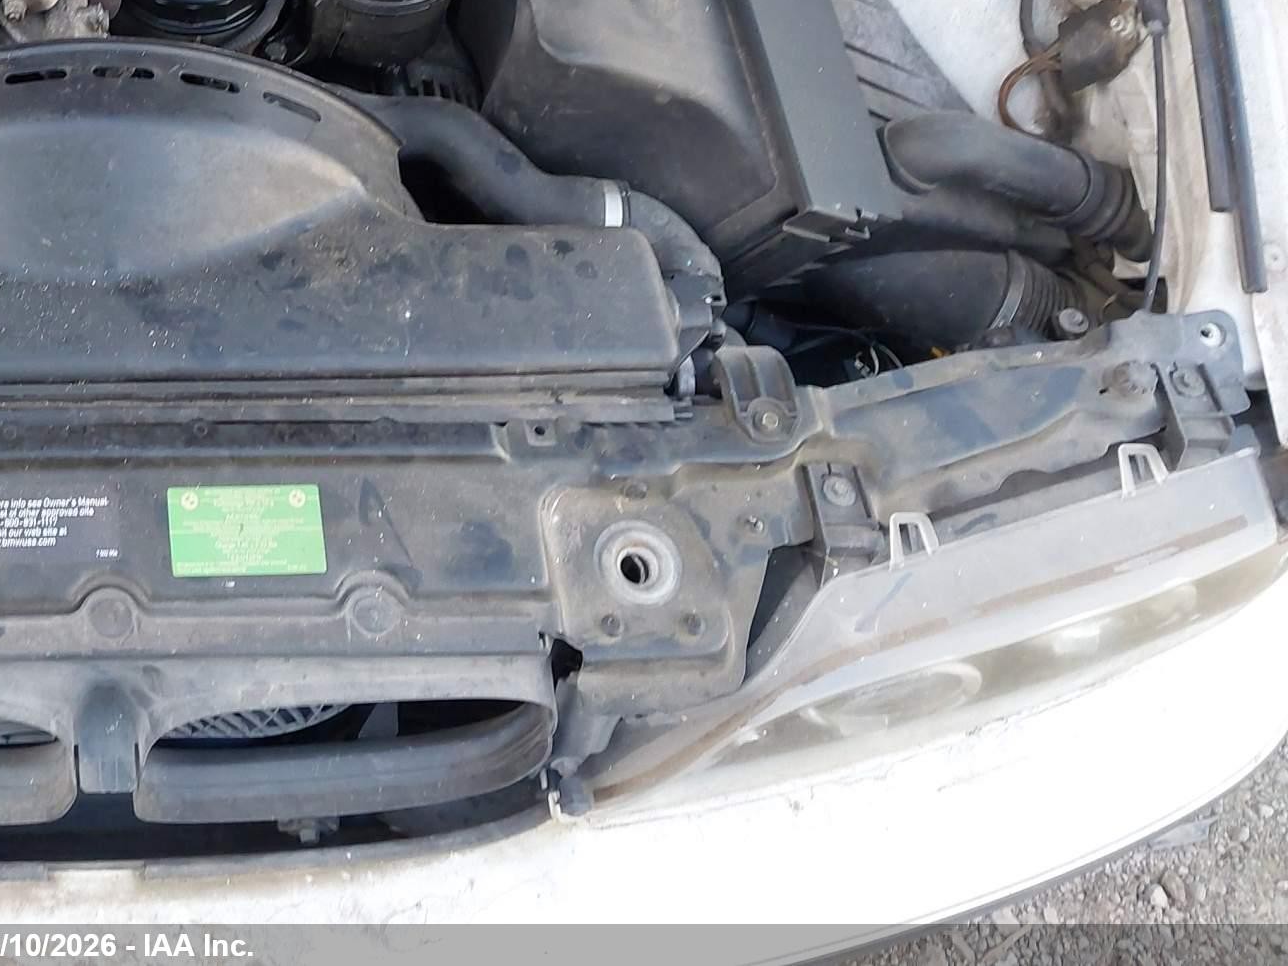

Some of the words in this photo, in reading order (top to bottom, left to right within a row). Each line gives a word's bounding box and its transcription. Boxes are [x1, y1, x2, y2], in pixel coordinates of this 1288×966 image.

[11, 498, 26, 509] info
[27, 498, 43, 508] see
[43, 497, 77, 508] Owner's
[78, 496, 109, 507] Manual
[9, 508, 17, 518] of
[19, 507, 40, 518] other
[41, 507, 78, 519] approved
[9, 528, 22, 537] our
[24, 528, 41, 537] web
[43, 527, 57, 536] site
